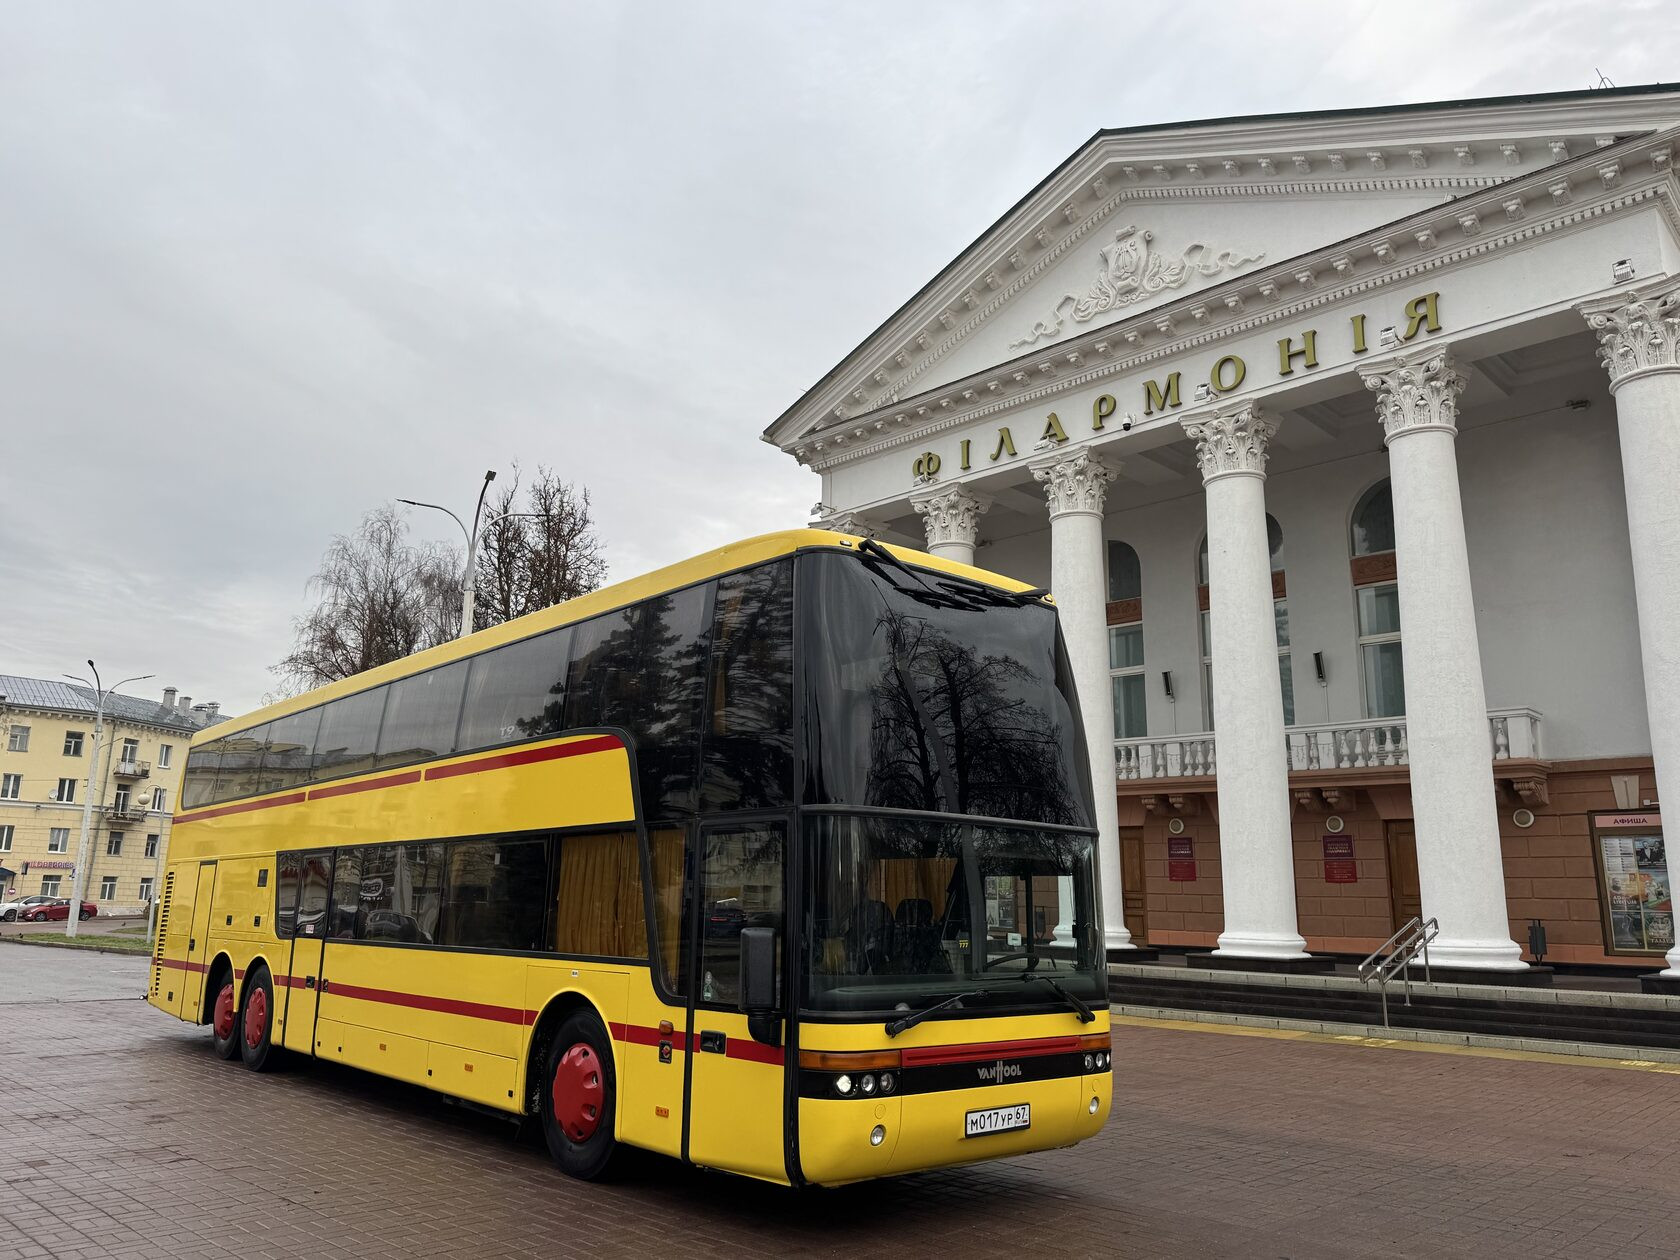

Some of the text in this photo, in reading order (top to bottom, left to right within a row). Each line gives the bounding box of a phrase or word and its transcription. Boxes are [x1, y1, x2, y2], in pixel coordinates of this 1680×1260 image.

[912, 291, 1443, 479] ФІЛАРМОНІЯ
[1613, 817, 1648, 825] АФИША
[1015, 1107, 1026, 1120] 67
